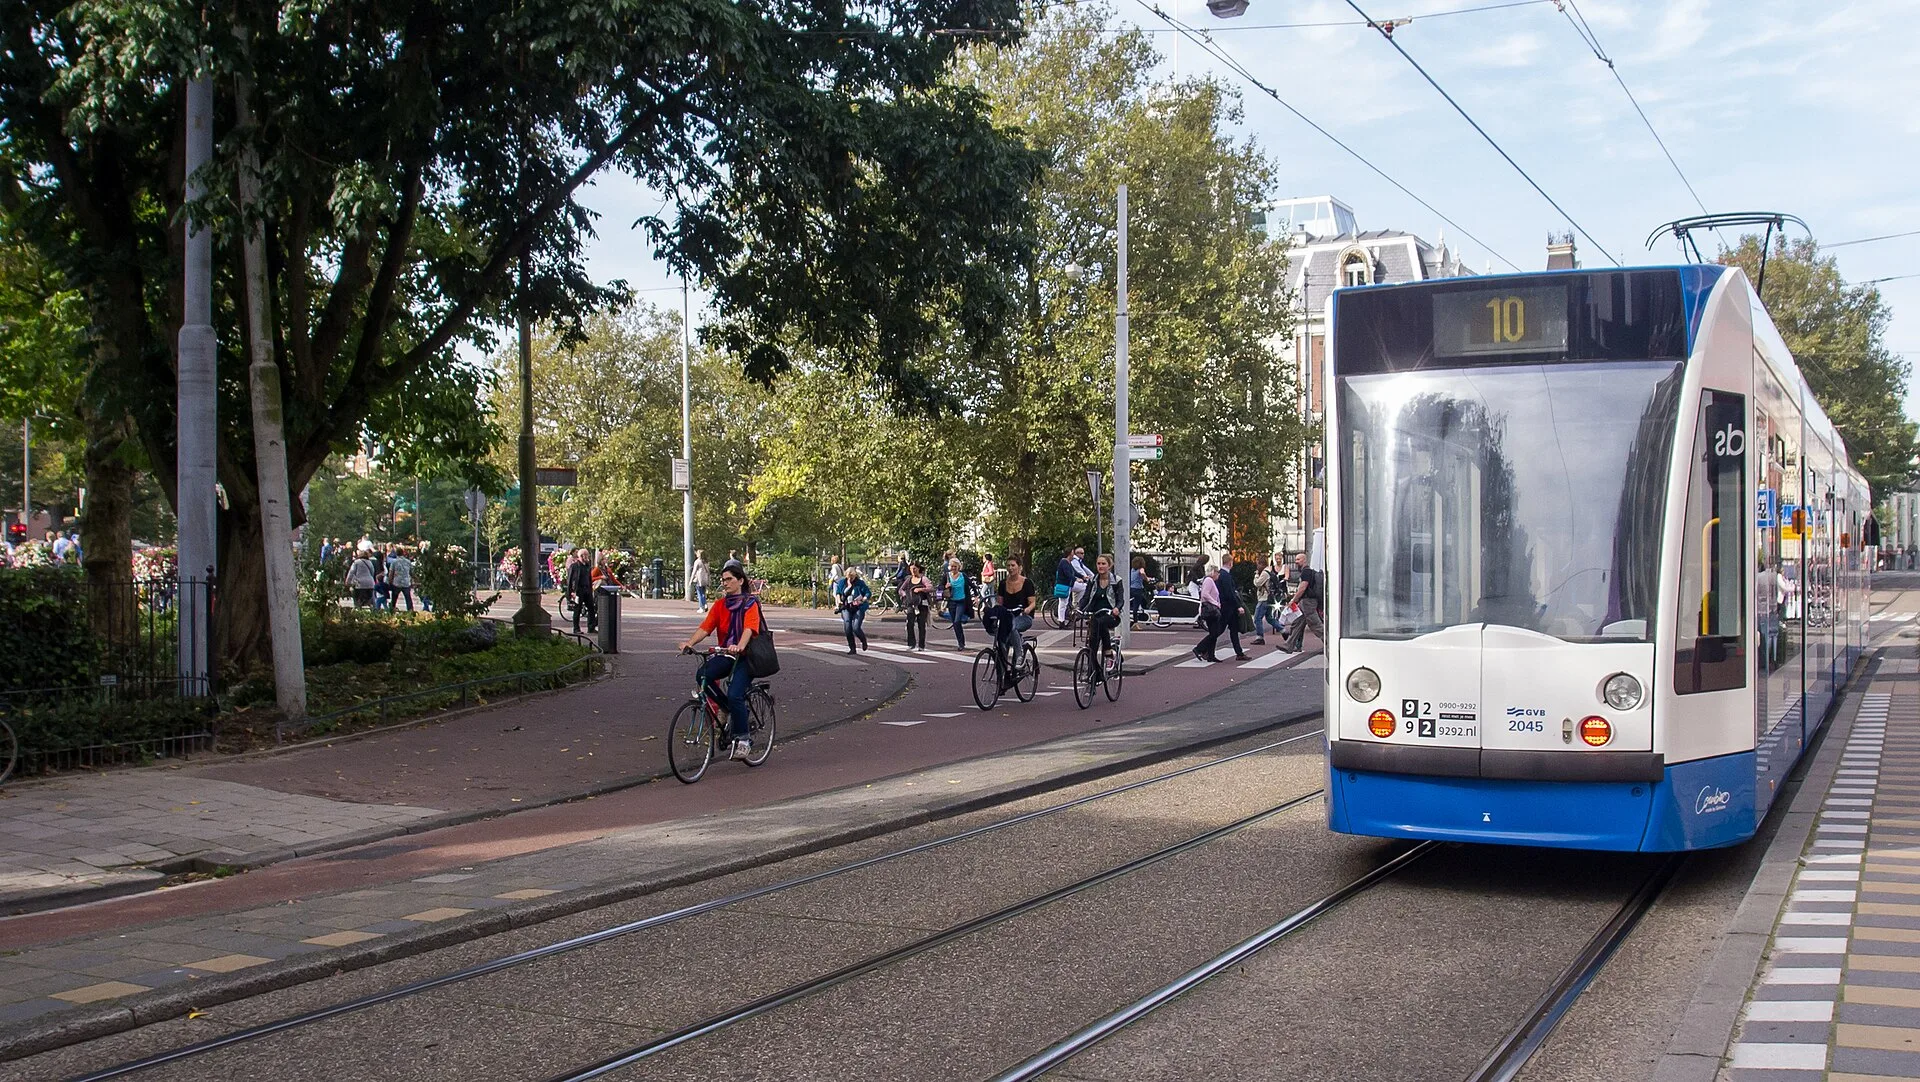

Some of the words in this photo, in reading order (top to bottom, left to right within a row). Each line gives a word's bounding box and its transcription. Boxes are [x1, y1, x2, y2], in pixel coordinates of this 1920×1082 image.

[1486, 296, 1524, 343] 10
[1439, 702, 1477, 710] 0900-9292
[1439, 725, 1477, 737] 9292.nl
[1508, 720, 1543, 732] 2045
